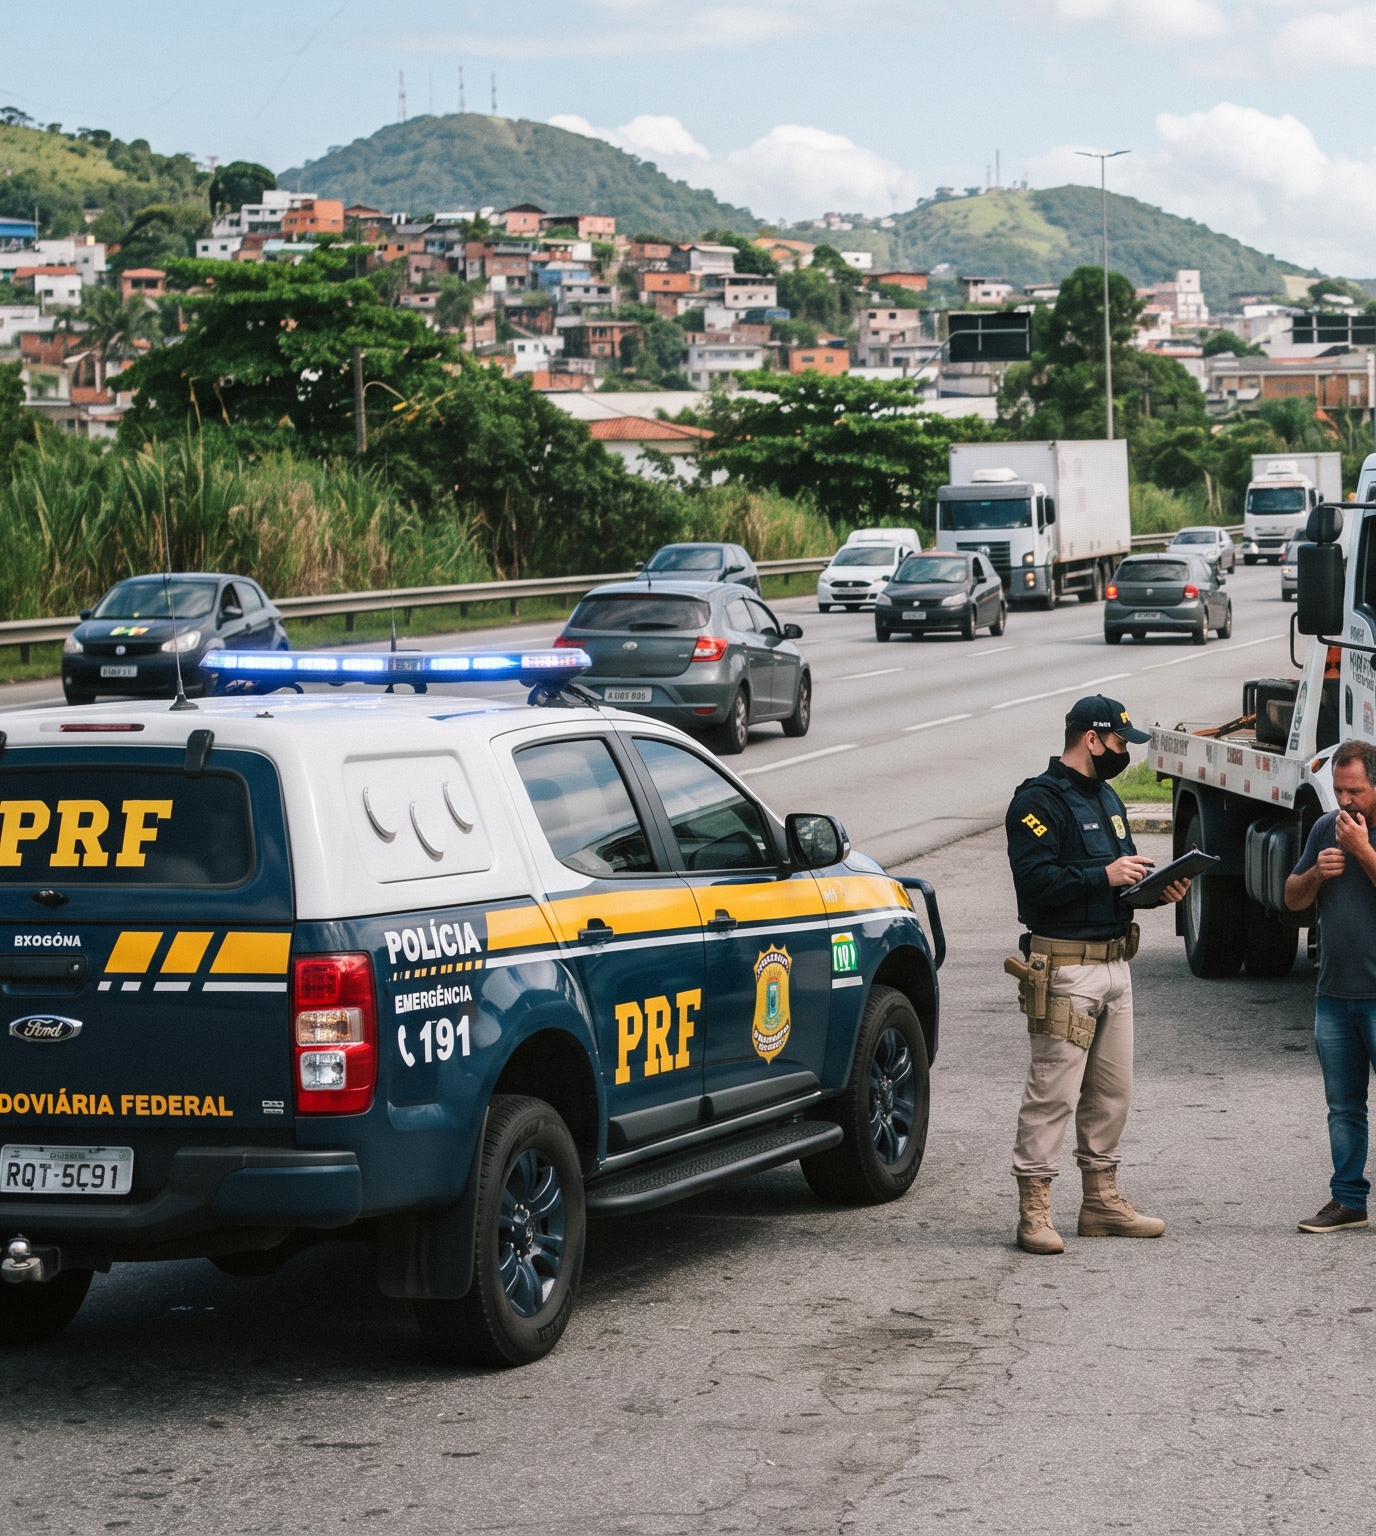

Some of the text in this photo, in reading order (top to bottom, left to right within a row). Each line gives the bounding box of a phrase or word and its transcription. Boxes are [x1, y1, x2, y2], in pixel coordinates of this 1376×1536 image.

[0, 800, 173, 867] PRF
[384, 918, 482, 964] POLÍCIA
[419, 1015, 471, 1064] 191
[615, 987, 702, 1085] PRF
[120, 1094, 234, 1117] FEDERAL
